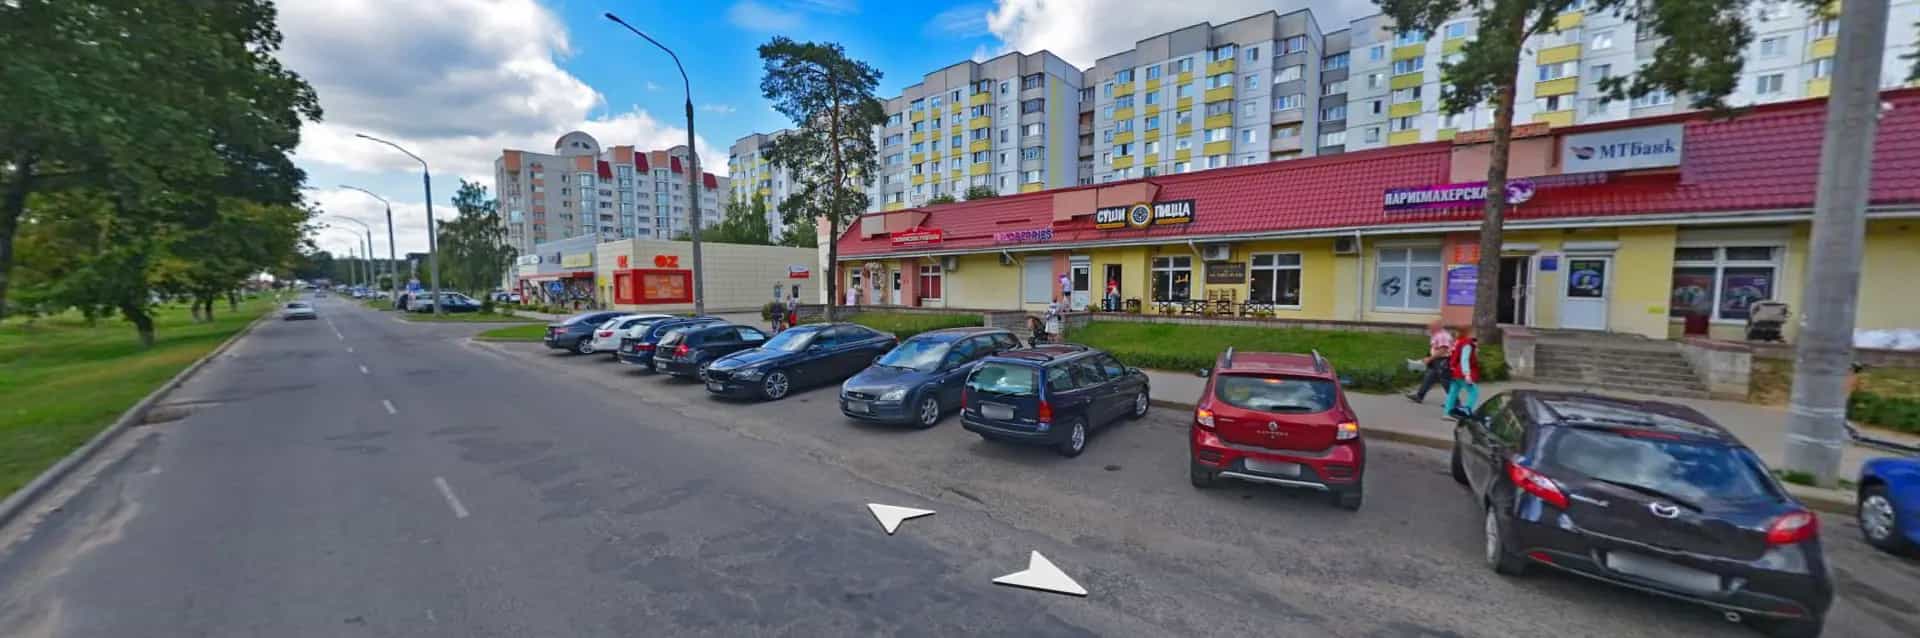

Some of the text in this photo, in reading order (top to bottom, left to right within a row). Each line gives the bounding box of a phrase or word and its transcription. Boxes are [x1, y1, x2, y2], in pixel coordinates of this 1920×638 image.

[1384, 186, 1488, 206] ПАРИМАХЕРСКА
[1097, 202, 1191, 224] СУШИ ПИЦЦА
